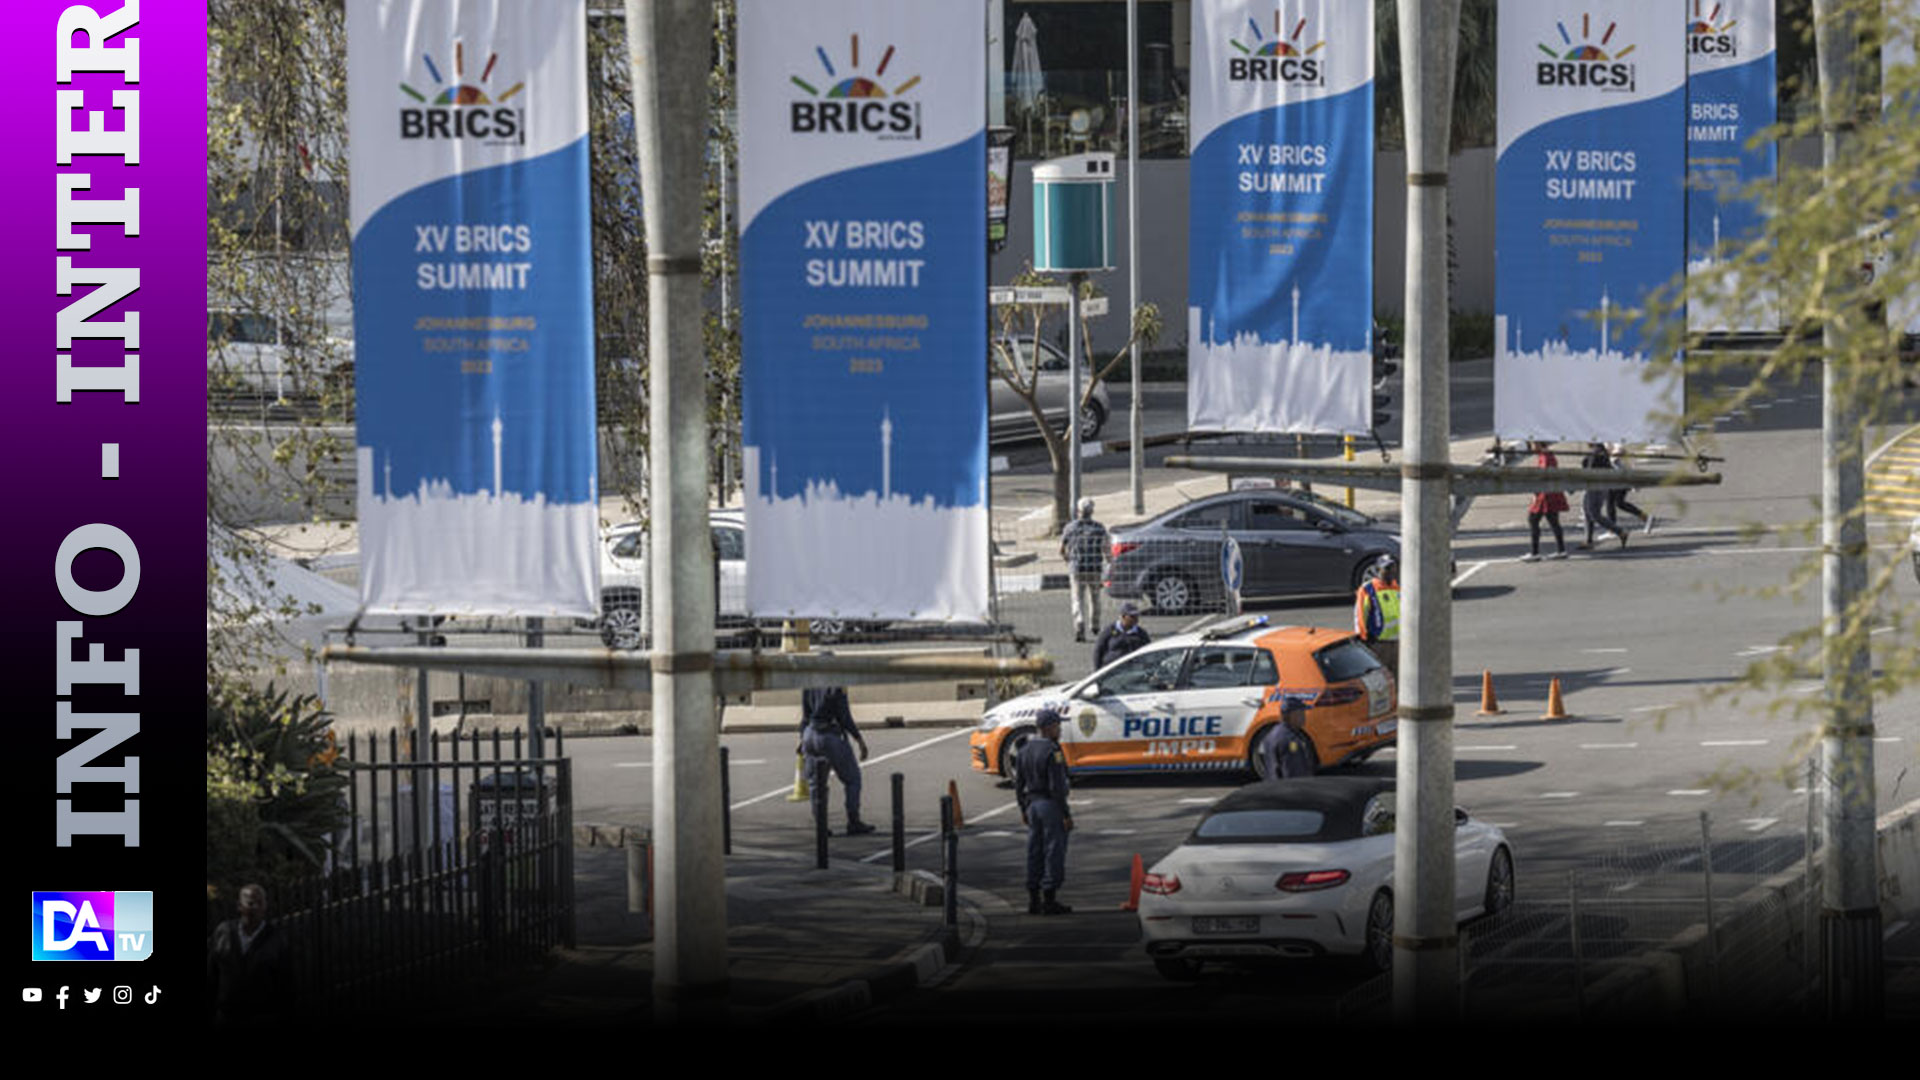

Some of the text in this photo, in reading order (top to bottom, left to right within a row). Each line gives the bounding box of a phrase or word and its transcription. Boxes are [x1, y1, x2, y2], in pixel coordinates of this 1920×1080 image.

[1688, 35, 1731, 54] ICS
[1230, 59, 1318, 81] BRICS
[1538, 63, 1628, 86] BRICS
[792, 101, 912, 133] BRICS
[1691, 103, 1739, 120] BRICS
[401, 108, 516, 138] BRICS
[1239, 144, 1326, 166] XV BRICS
[1546, 150, 1636, 171] XV BRICS
[1239, 172, 1326, 193] SUMMIT
[1546, 179, 1636, 200] SUMMIT
[415, 225, 531, 252] XV BRICS
[805, 221, 925, 249] XV BRICS
[417, 263, 532, 289] SUMMIT
[806, 260, 925, 287] SUMMIT
[803, 314, 929, 328] JOHANNESBURG
[812, 335, 921, 350] SOUTH AFRICA
[1123, 715, 1222, 738] POLICE
[1142, 739, 1216, 757] JMPD
